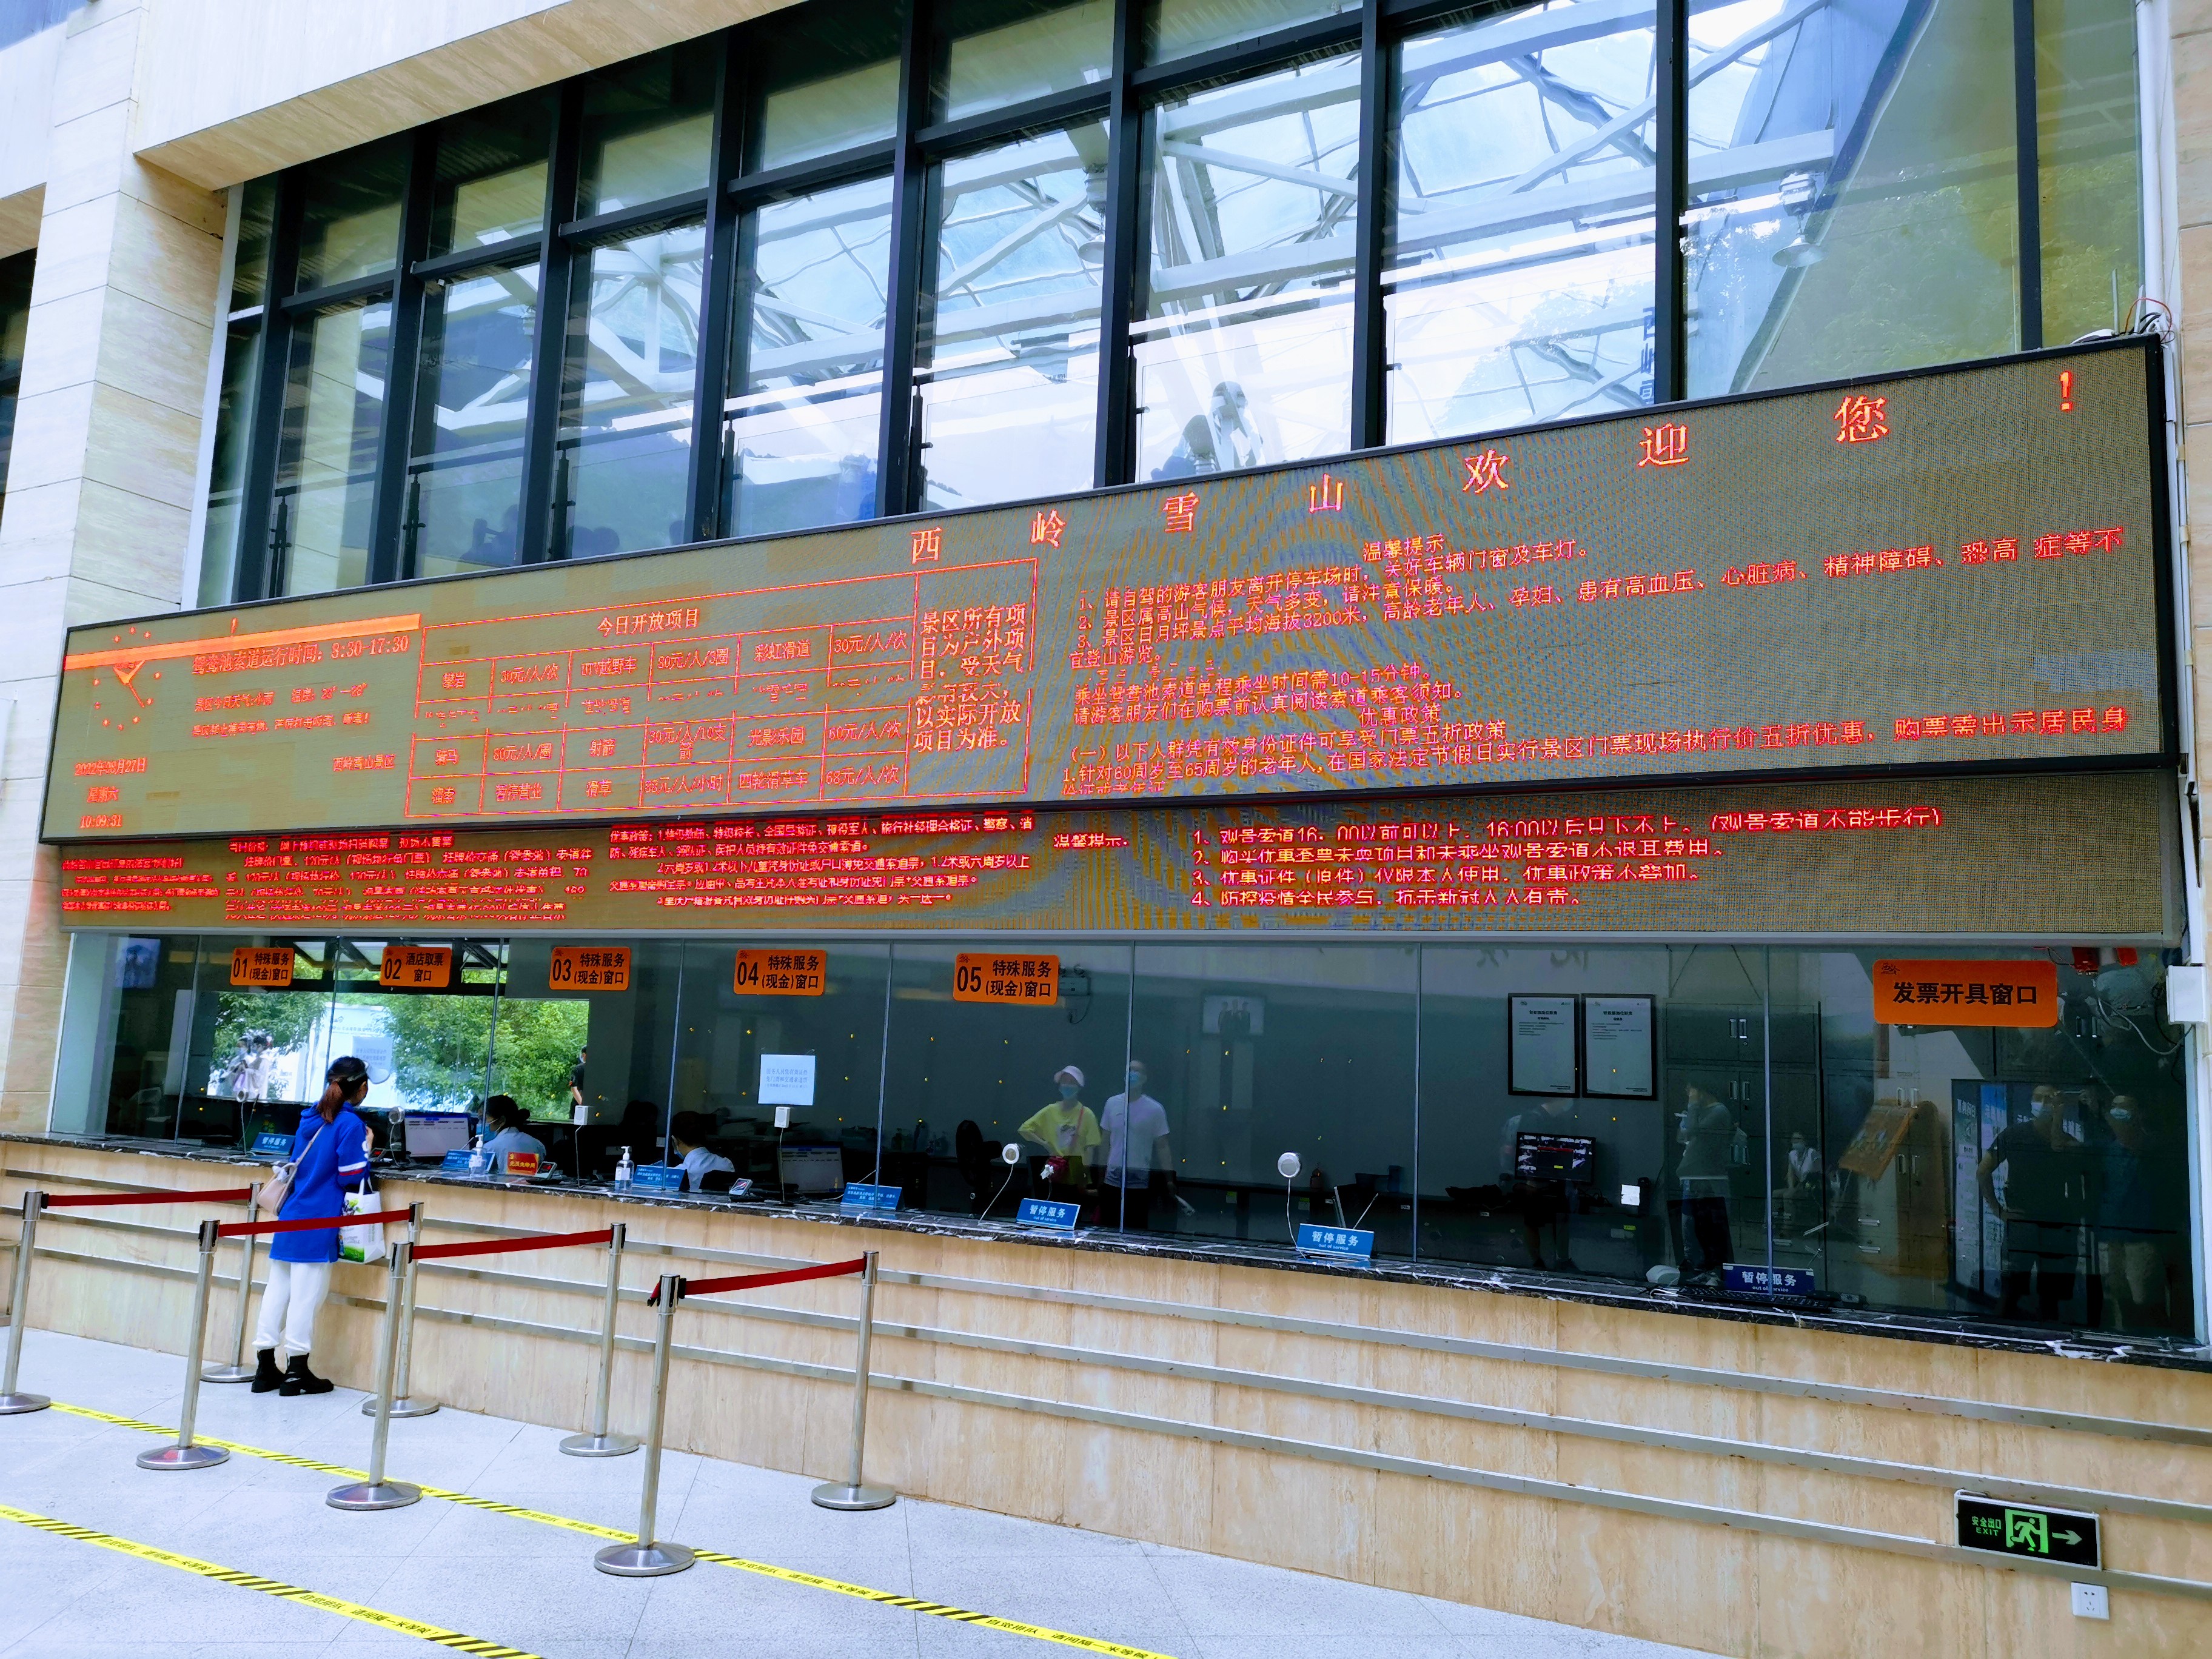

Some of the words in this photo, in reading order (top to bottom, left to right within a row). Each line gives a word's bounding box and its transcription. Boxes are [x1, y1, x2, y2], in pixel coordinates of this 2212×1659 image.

[1363, 534, 1444, 562] 温馨提示
[597, 608, 699, 638] 今日开放项目
[920, 603, 1027, 635] 景区所有项
[920, 627, 1025, 658] 目为户外项
[916, 700, 1021, 729] 以实际开放
[1359, 703, 1442, 728] 优惠政策
[590, 739, 615, 757] 射箭
[748, 726, 805, 748] 光影乐园
[914, 729, 1009, 754] 项目为准。
[333, 754, 395, 772] 西岭雪山景区
[87, 786, 119, 802] 星期六
[495, 782, 542, 802] 暂停营业
[586, 780, 612, 797] 滑草
[80, 814, 122, 828] 10:09:31
[233, 957, 248, 978] 01
[253, 953, 290, 966] 特殊服务
[384, 957, 402, 980] 02
[405, 953, 444, 967] 酒店取票
[552, 959, 572, 982] 03
[580, 953, 626, 968] 特殊服务
[768, 955, 820, 971] 特殊服务
[992, 960, 1052, 979] 特殊服务
[737, 962, 759, 987] 04
[957, 966, 982, 993] 05
[1892, 981, 2037, 1005] 发票开具窗口
[1030, 1204, 1066, 1218] 暂停服务
[1312, 1231, 1358, 1246] 暂停服务
[1742, 1271, 1797, 1287] 暂停服务
[1971, 1516, 2002, 1530] 安全出口
